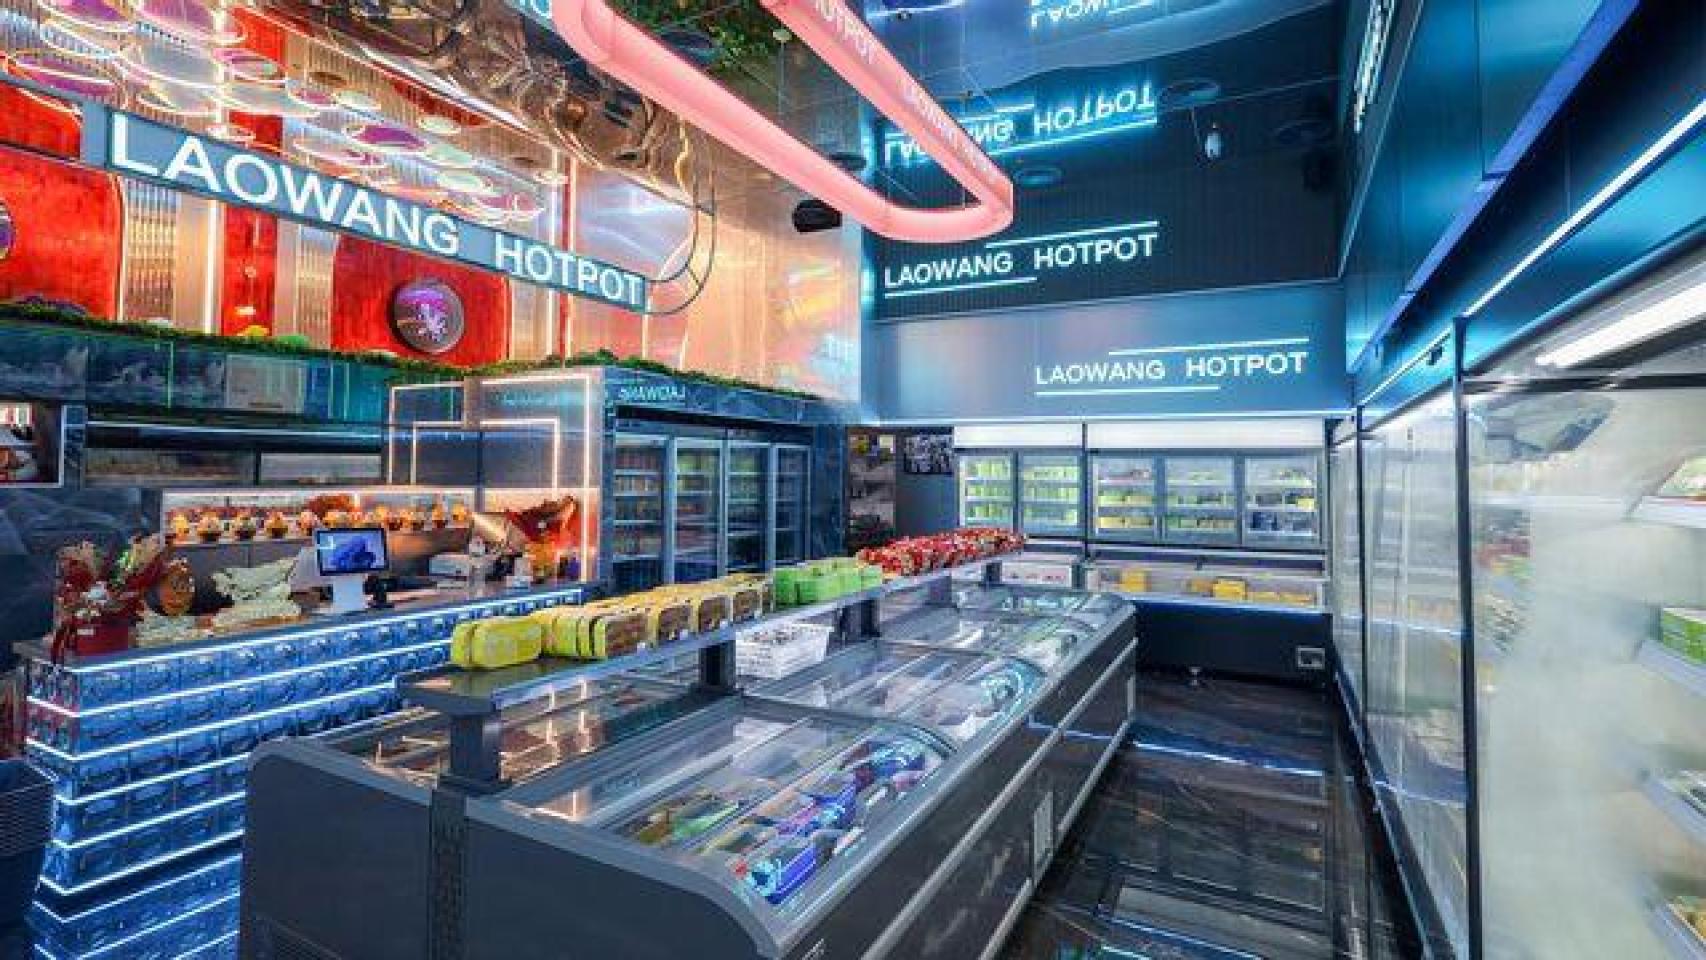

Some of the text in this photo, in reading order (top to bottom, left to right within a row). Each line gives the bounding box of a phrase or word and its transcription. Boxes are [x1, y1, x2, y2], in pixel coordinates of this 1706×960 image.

[112, 113, 644, 308] LAOWANG HOTPOT
[884, 232, 1159, 289] LAOWANG HOTPOT
[1035, 351, 1308, 386] LAOWANG HOTPOT
